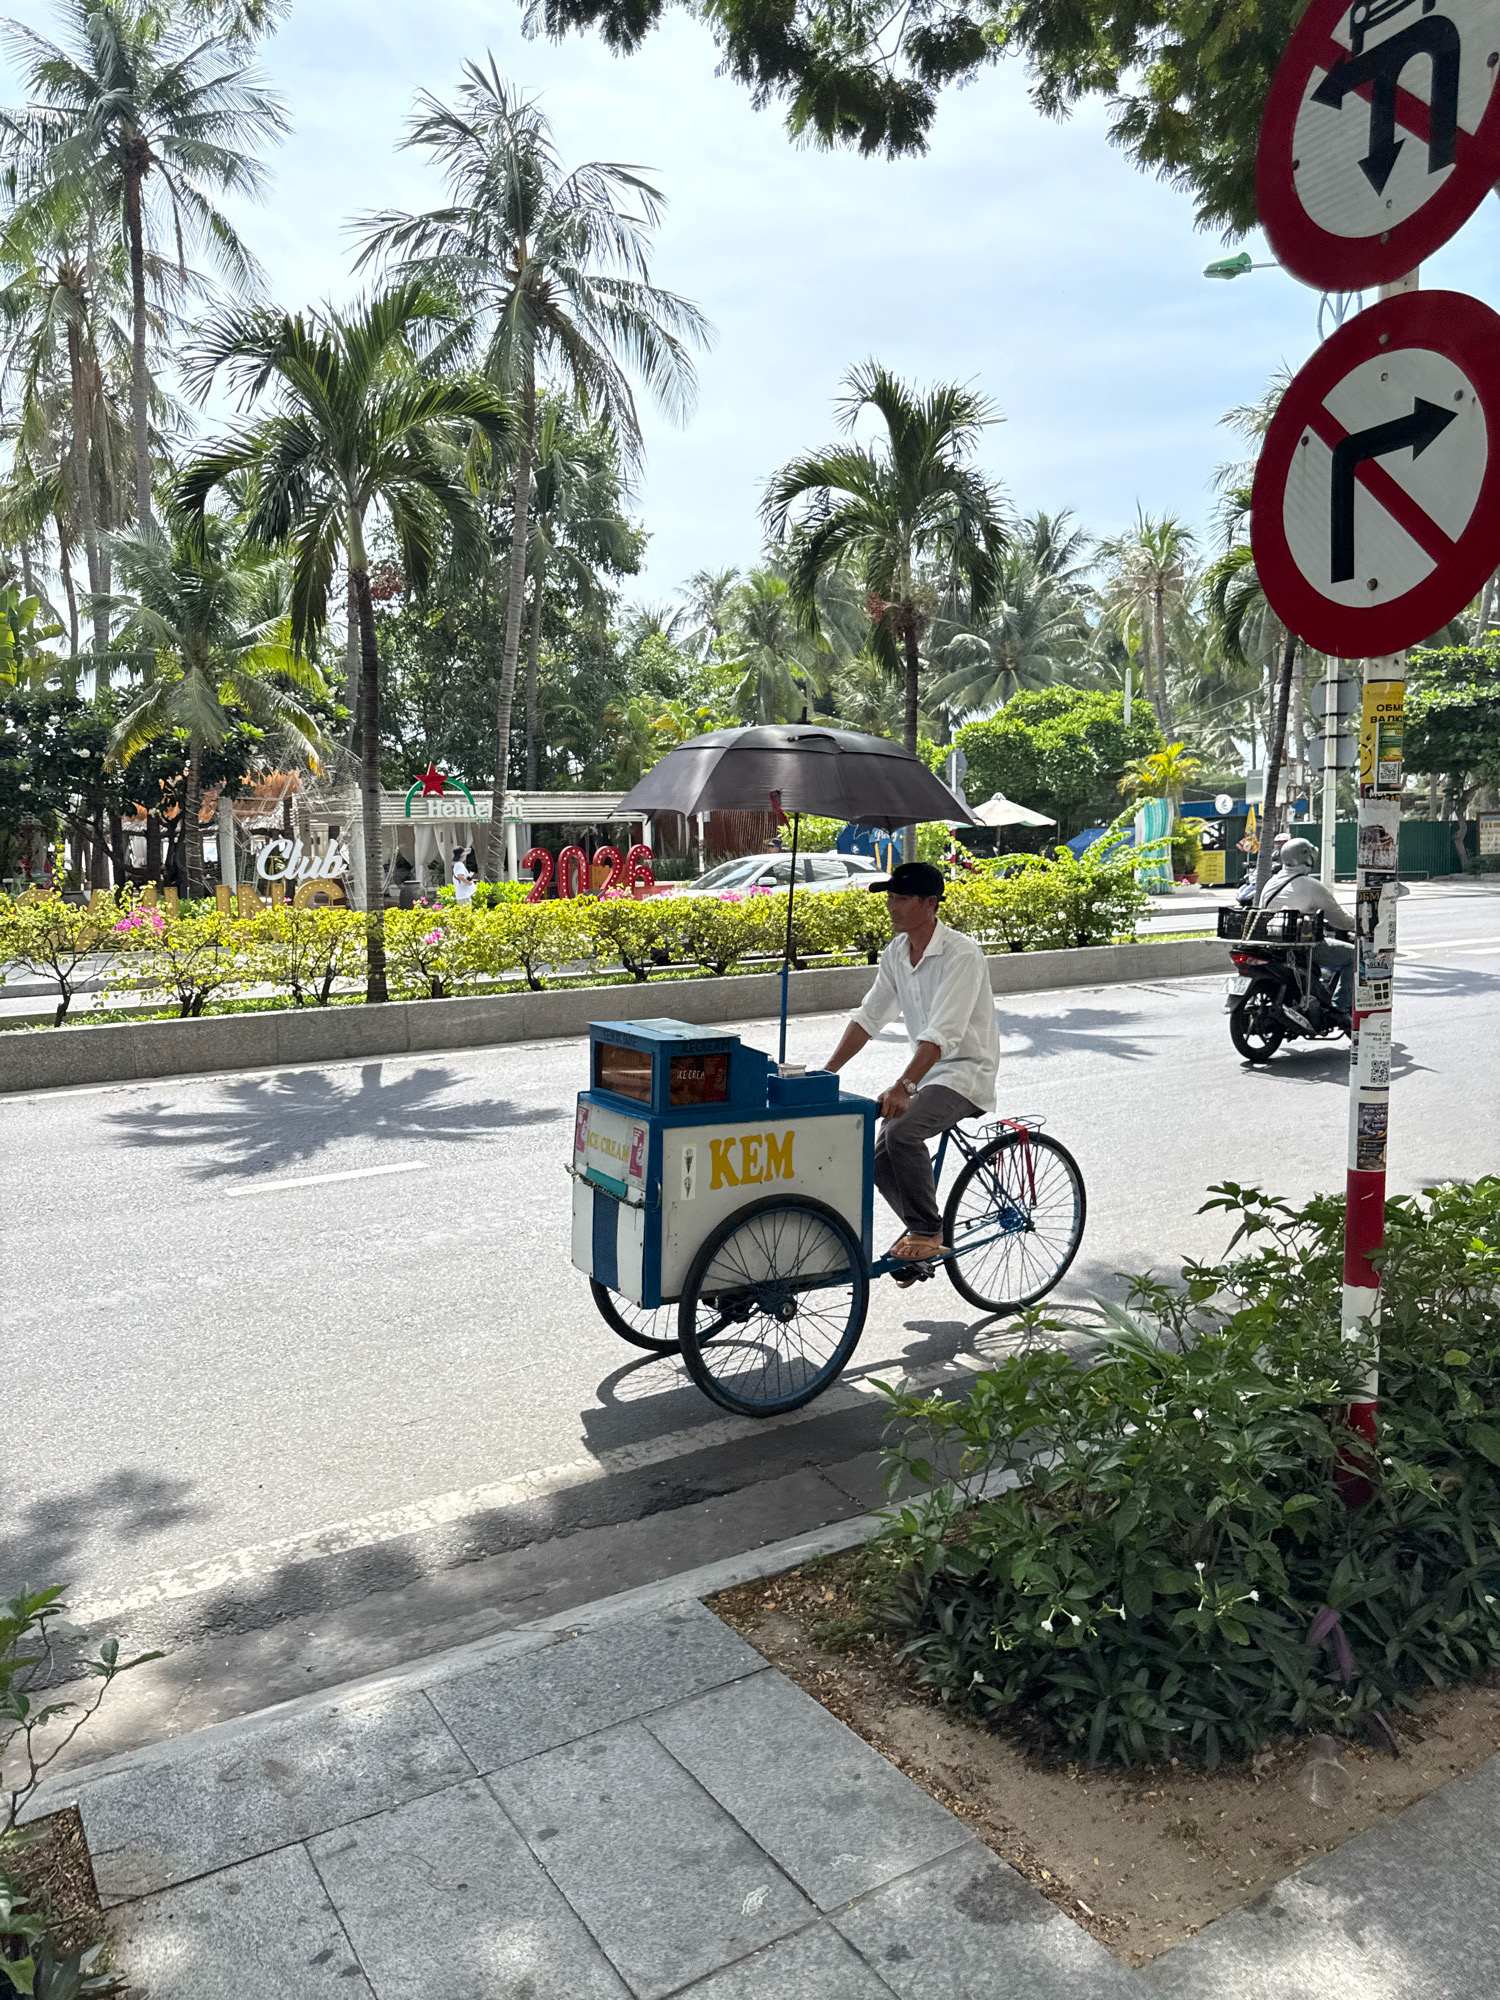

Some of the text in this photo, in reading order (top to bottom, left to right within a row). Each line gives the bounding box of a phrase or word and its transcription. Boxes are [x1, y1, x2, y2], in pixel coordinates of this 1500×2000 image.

[427, 799, 523, 819] Heineen
[257, 838, 348, 881] Club
[522, 843, 655, 903] 2026
[586, 1129, 630, 1164] ICE CREAM
[708, 1130, 795, 1190] KEM
